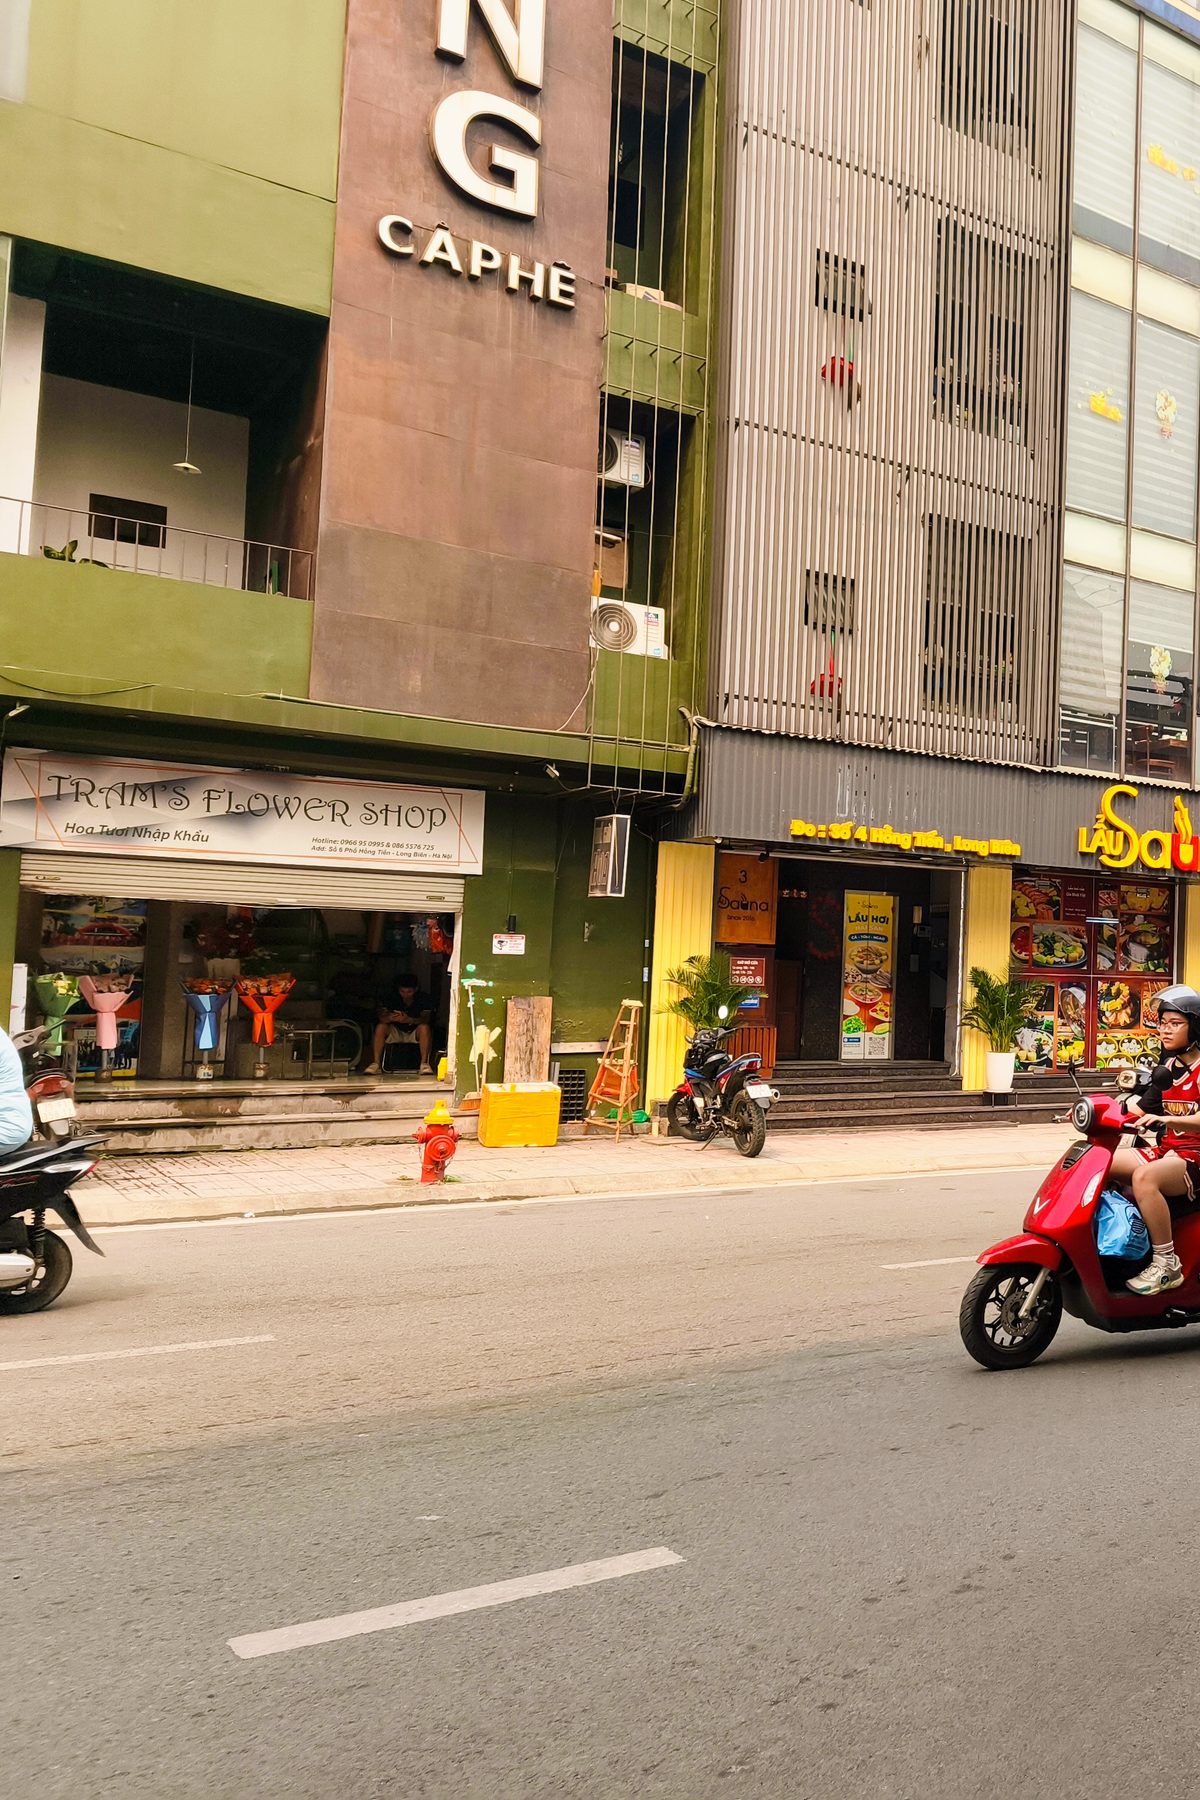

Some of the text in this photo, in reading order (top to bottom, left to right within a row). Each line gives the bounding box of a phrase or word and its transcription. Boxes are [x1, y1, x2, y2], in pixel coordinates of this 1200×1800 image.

[203, 789, 351, 827] FLOWER
[359, 801, 447, 834] SHOP
[64, 823, 210, 843] Hoa Tươi Nhập Khẩu
[312, 837, 339, 845] Hotline:
[854, 825, 868, 842] 4
[869, 824, 912, 850] Hồng
[953, 835, 989, 857] Long
[1078, 813, 1125, 857] LẨU
[739, 870, 748, 884] 3
[718, 886, 769, 911] Sauna
[848, 912, 889, 924] LẨU HƠI
